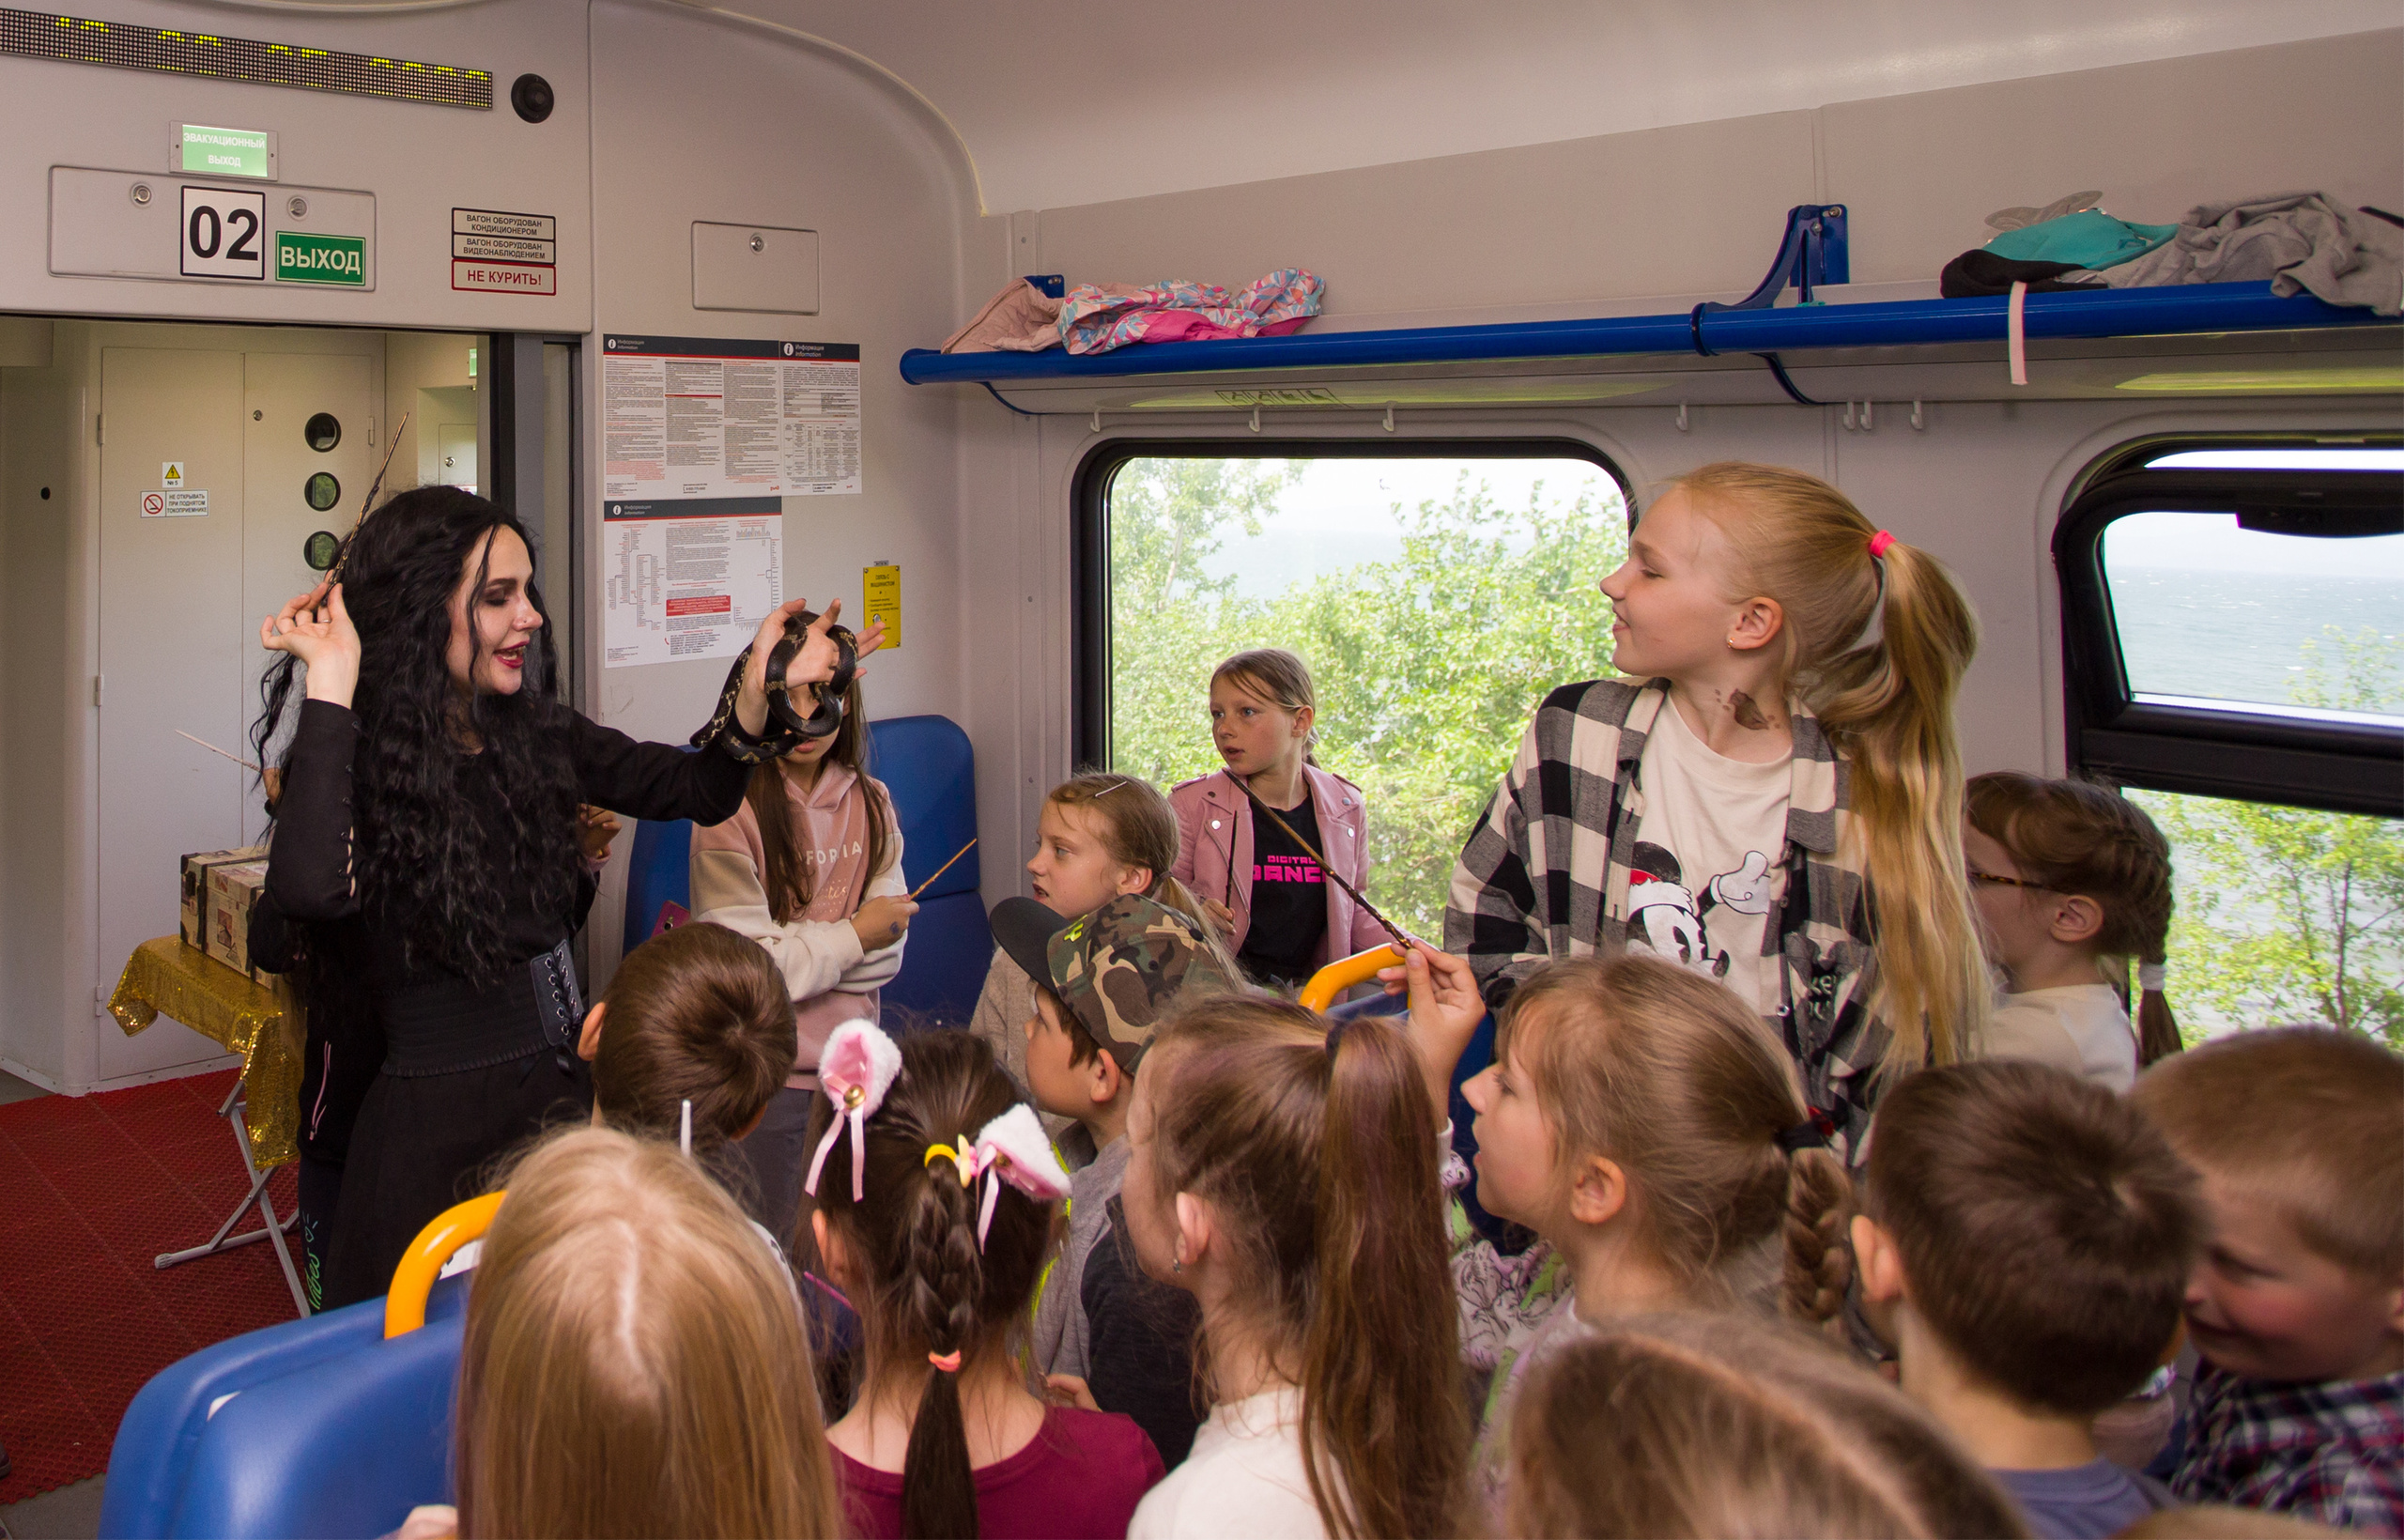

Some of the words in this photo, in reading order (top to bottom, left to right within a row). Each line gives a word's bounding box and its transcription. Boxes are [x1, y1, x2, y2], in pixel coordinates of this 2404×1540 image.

[183, 132, 266, 149] ЭВАКУАЦИОННЫЙ
[208, 155, 241, 167] ВЫХОД
[466, 214, 491, 223] ВАГОН
[493, 216, 542, 227] ОБОРУДОВАН
[189, 205, 259, 261] 02
[471, 223, 537, 236] КОНДИЦИОНЕРОМ
[466, 238, 491, 247] ВАГОН
[493, 239, 542, 251] ОБОРУДОВАН
[463, 247, 545, 259] ВИДЕОНАБЛЮДЕНИЕМ
[281, 246, 361, 276] ВЫХОД
[468, 270, 485, 282] НЕ
[488, 270, 542, 285] КУРИТЬ!
[800, 840, 862, 865] FORIA
[1267, 855, 1316, 864] DIGITAL
[1253, 864, 1326, 883] ANC
